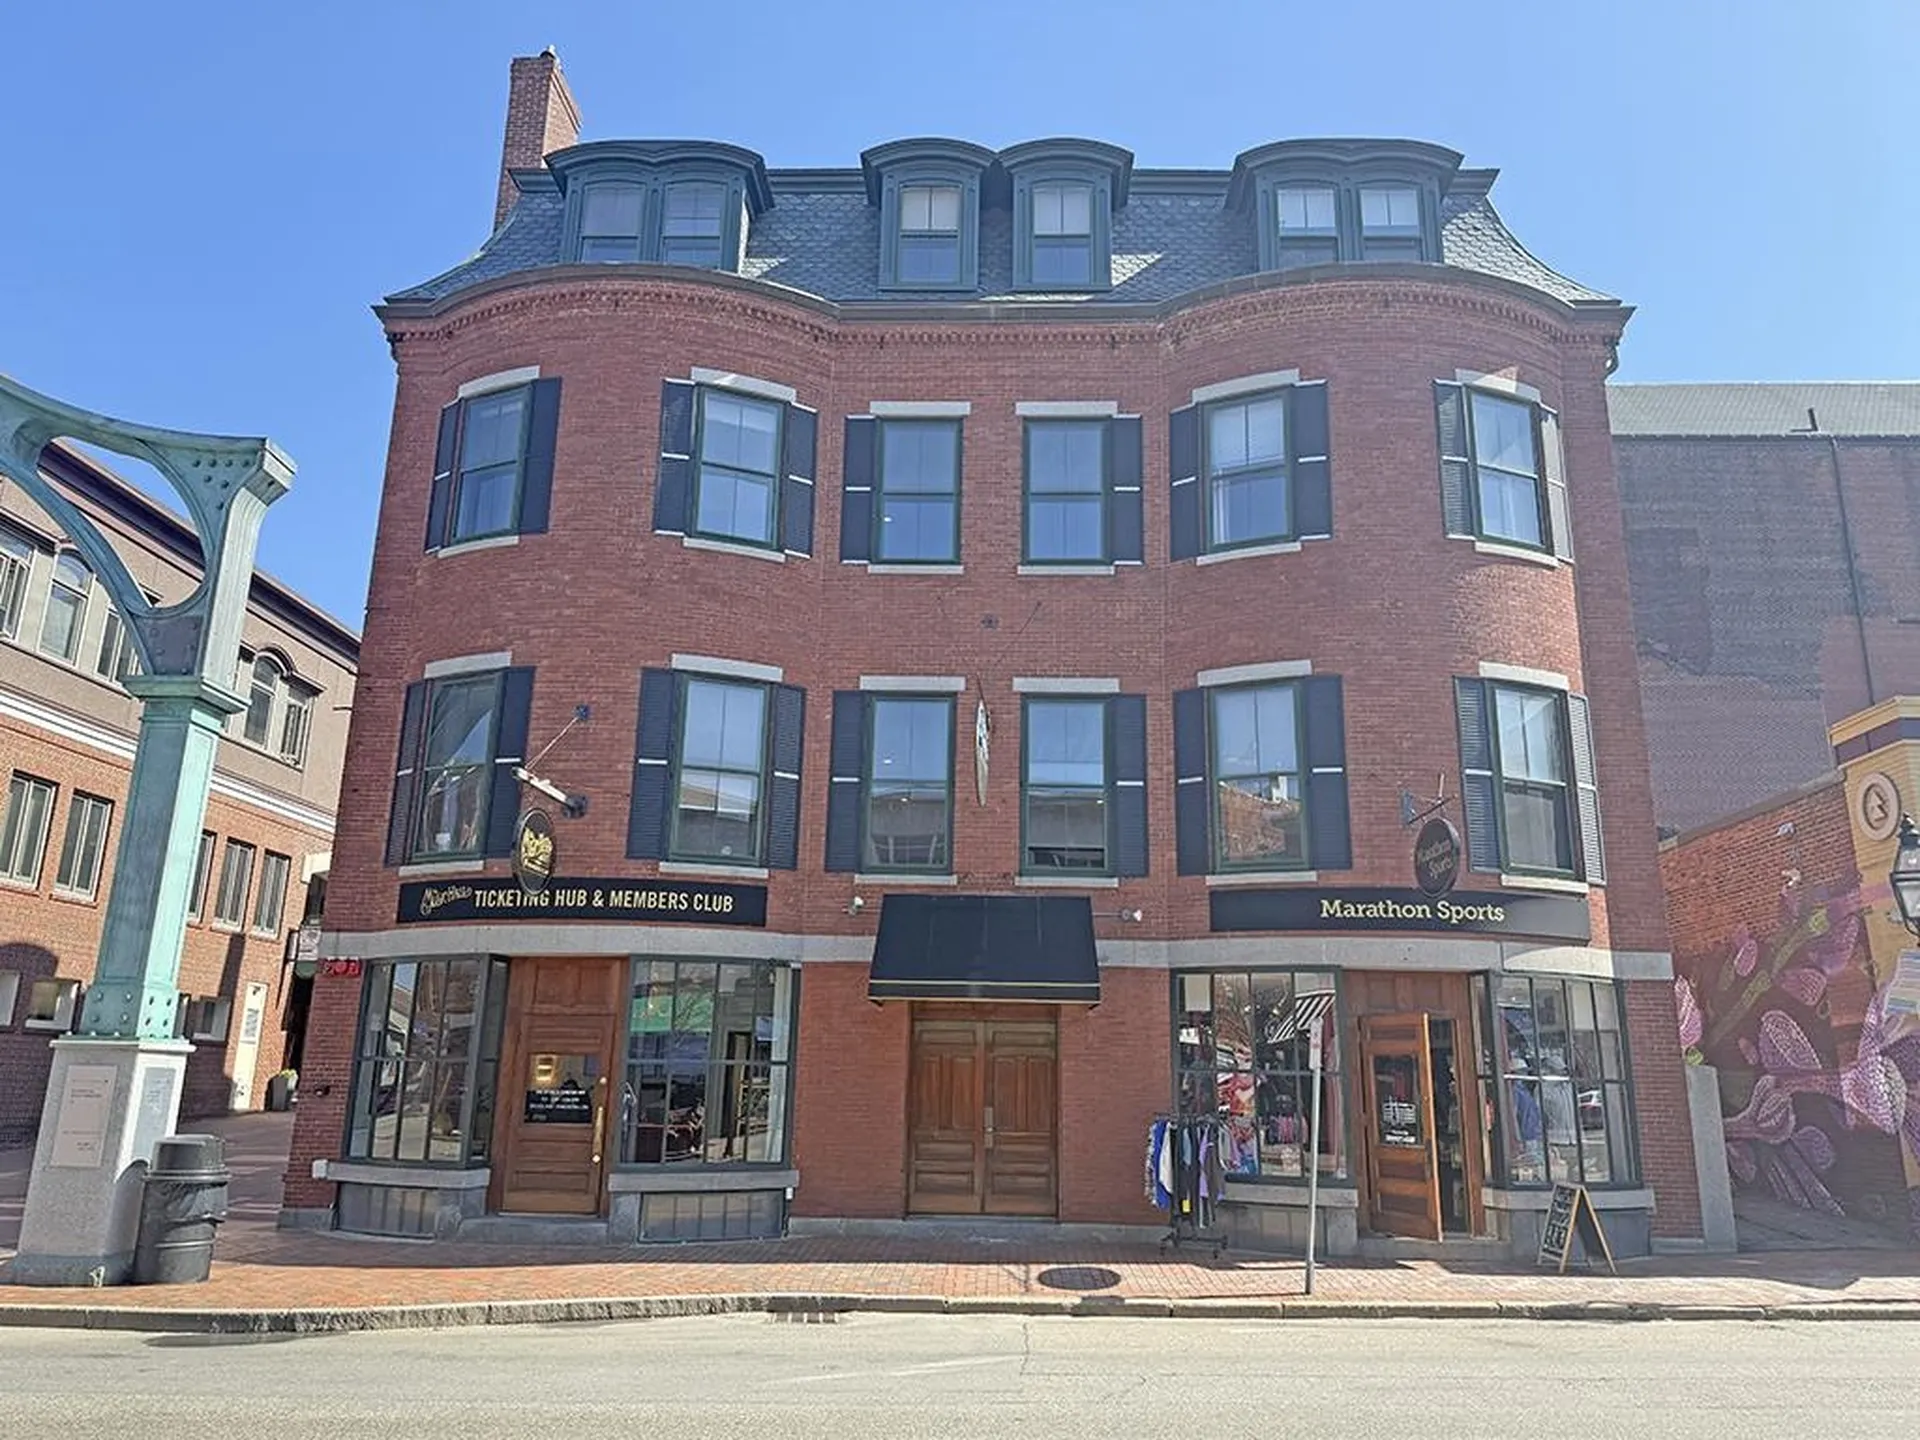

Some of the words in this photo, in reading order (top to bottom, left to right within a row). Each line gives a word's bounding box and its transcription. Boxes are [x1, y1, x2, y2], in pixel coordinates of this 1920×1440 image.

[554, 889, 587, 907] HUB
[592, 889, 604, 907] &
[609, 890, 689, 911] MEMBERS
[693, 893, 734, 913] CLUB
[1320, 899, 1432, 918] Marathon
[1437, 900, 1505, 924] Sports
